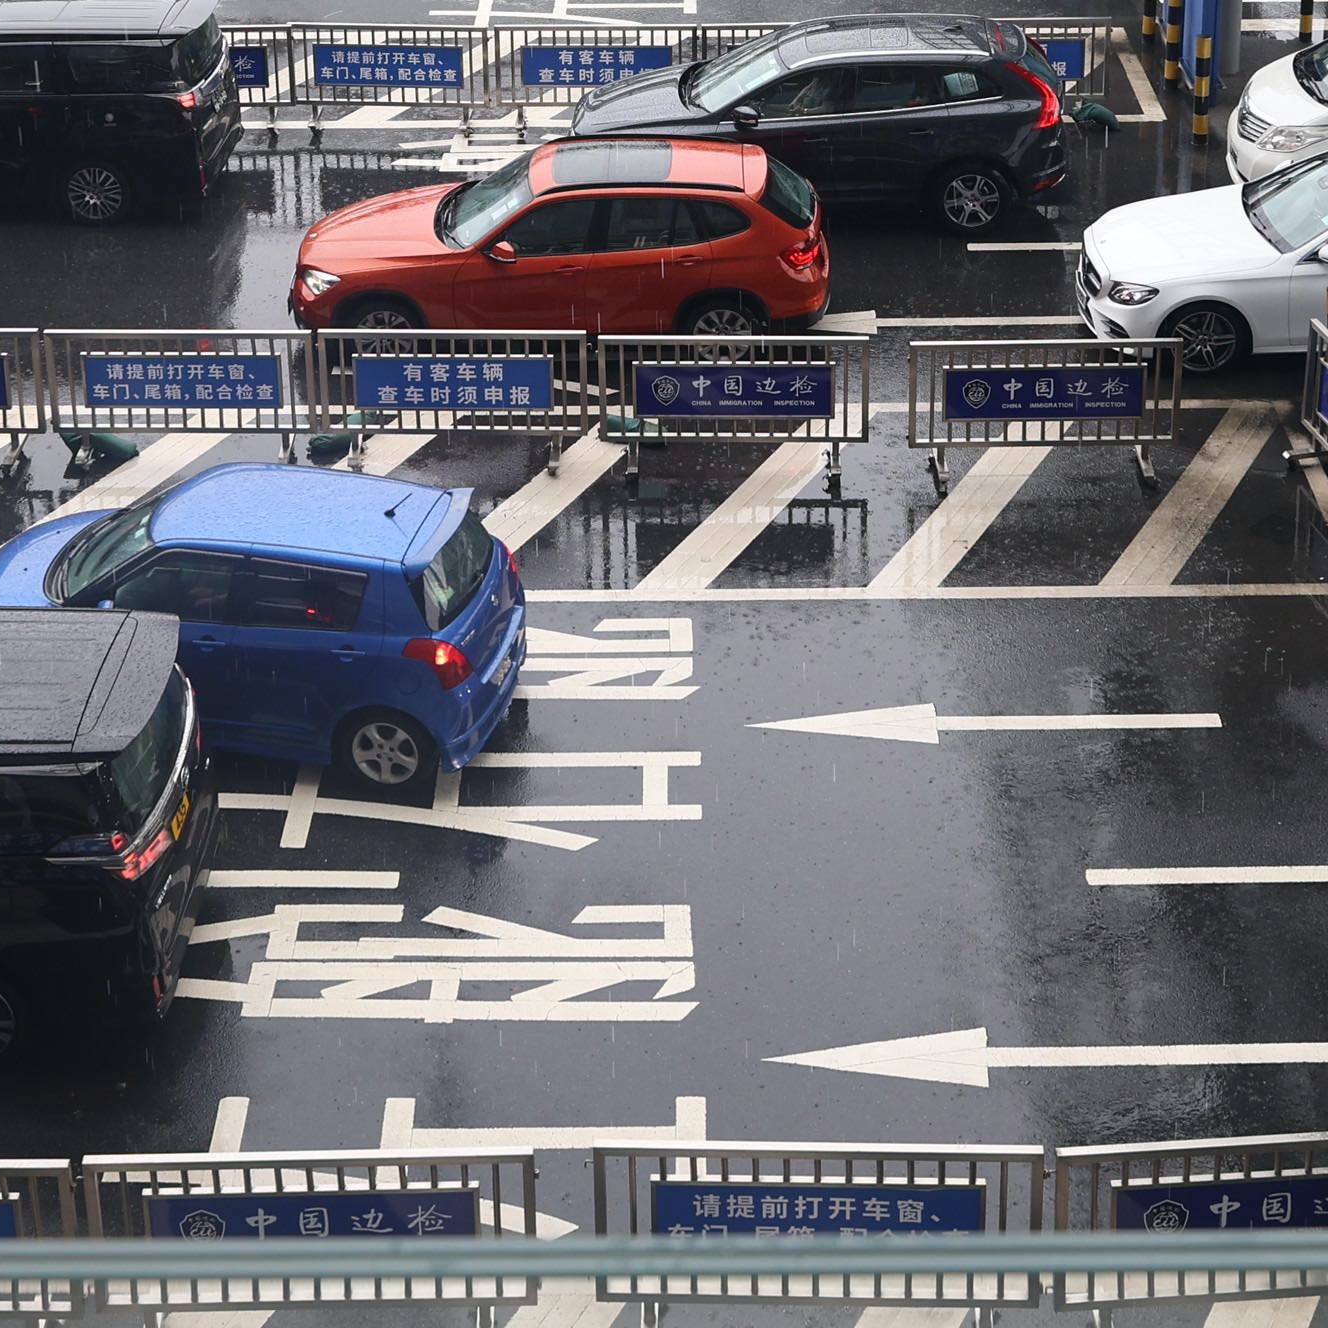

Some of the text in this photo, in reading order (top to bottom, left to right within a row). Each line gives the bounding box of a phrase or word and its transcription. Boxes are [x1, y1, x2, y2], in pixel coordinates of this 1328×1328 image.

[330, 50, 446, 66] 请提前打开车窗、
[558, 50, 635, 65] 有客车辆
[539, 67, 654, 83] 查车时须申
[105, 363, 258, 381] 请提前打开车窗、
[403, 362, 505, 382] 有客车辆
[377, 384, 531, 406] 查车时须申报
[691, 374, 819, 397] 中国边检
[1002, 376, 1130, 400] 中国边检
[718, 399, 763, 407] IMMIGRATION
[773, 399, 816, 407] INSPECTION
[1029, 401, 1074, 409] IMMIGRATION
[692, 1194, 942, 1224] 请提前打开车窗、
[245, 1204, 453, 1240] 中国边检
